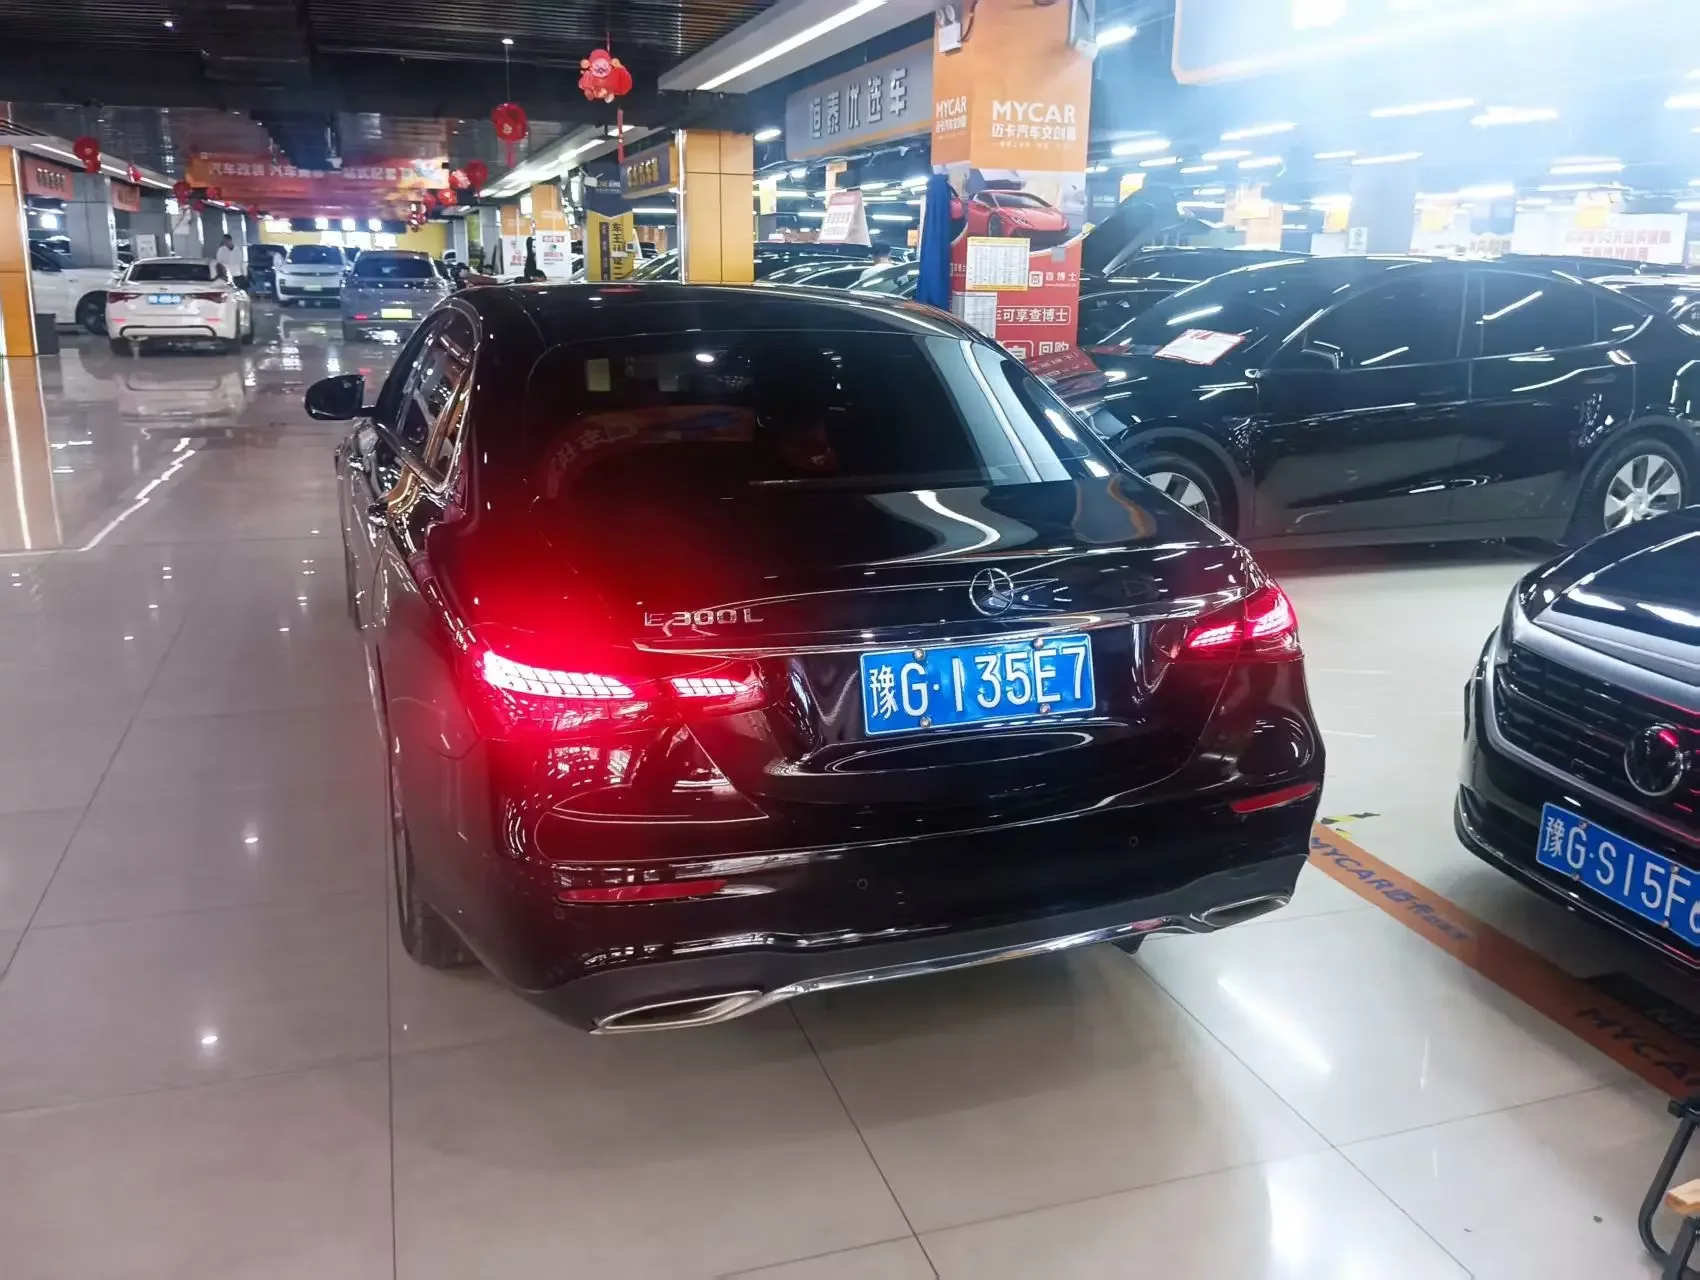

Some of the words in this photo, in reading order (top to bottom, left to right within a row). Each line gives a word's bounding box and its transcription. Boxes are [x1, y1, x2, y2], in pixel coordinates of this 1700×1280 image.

[808, 67, 909, 140] 恒泰优选车
[935, 95, 967, 118] MYCAR
[991, 100, 1077, 124] MYCAR
